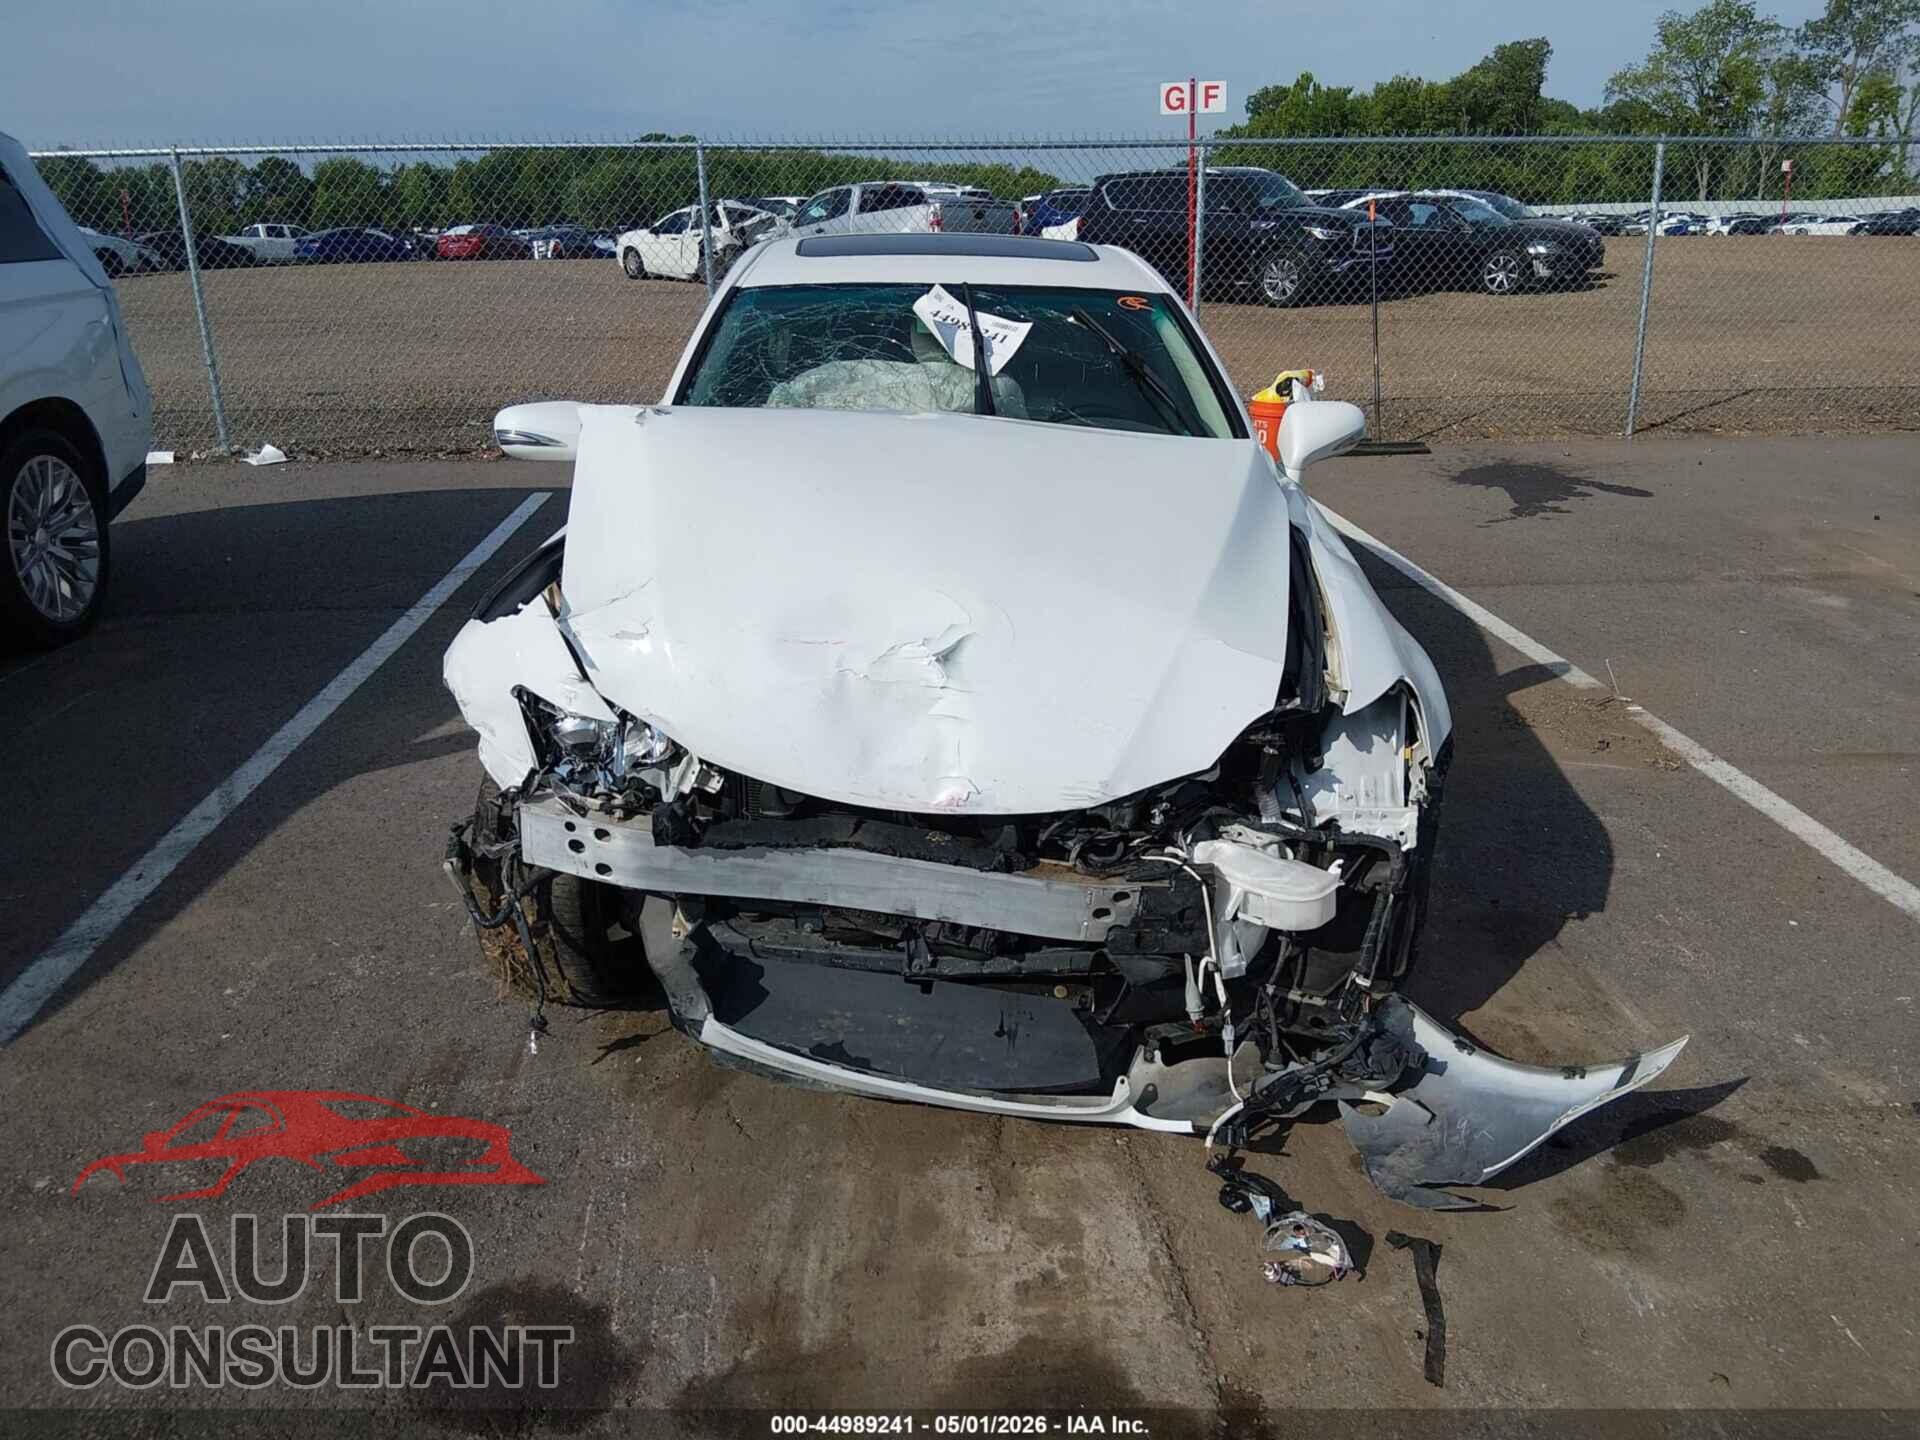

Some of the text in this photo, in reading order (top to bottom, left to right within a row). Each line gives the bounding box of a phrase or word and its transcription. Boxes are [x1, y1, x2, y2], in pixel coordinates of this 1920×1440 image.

[1165, 86, 1185, 111] G
[1204, 85, 1220, 109] F
[930, 309, 1008, 344] 4498241
